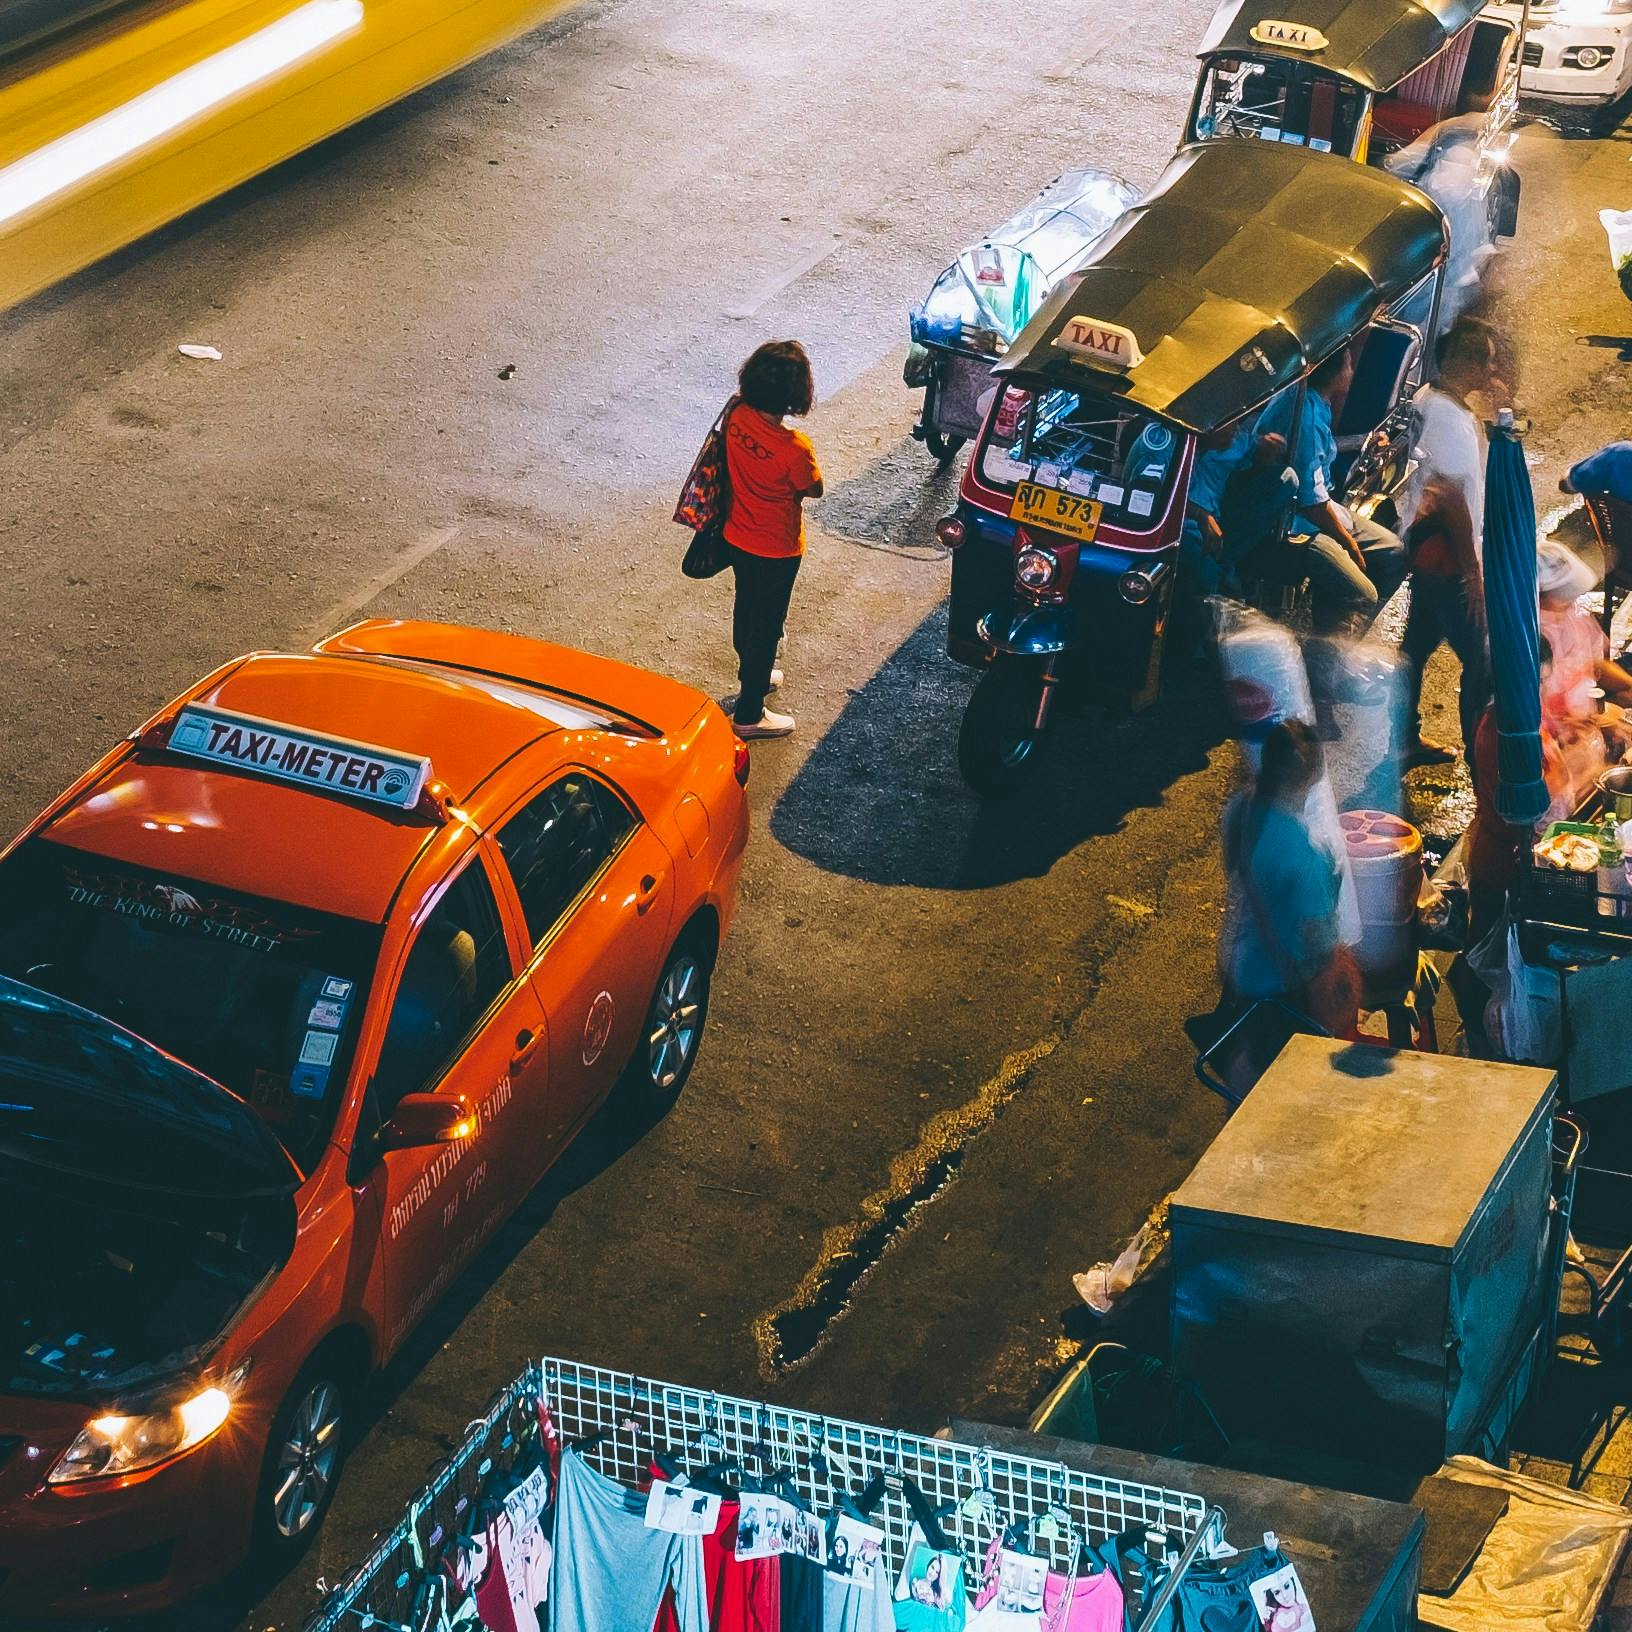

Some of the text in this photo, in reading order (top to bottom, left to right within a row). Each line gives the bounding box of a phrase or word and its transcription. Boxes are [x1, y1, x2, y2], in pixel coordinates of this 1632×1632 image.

[1267, 25, 1307, 43] TAXI
[1071, 324, 1123, 355] TAXI
[1056, 497, 1093, 523] 573
[206, 722, 387, 795] TAXI-METER
[68, 885, 282, 952] THE KING OF STREET
